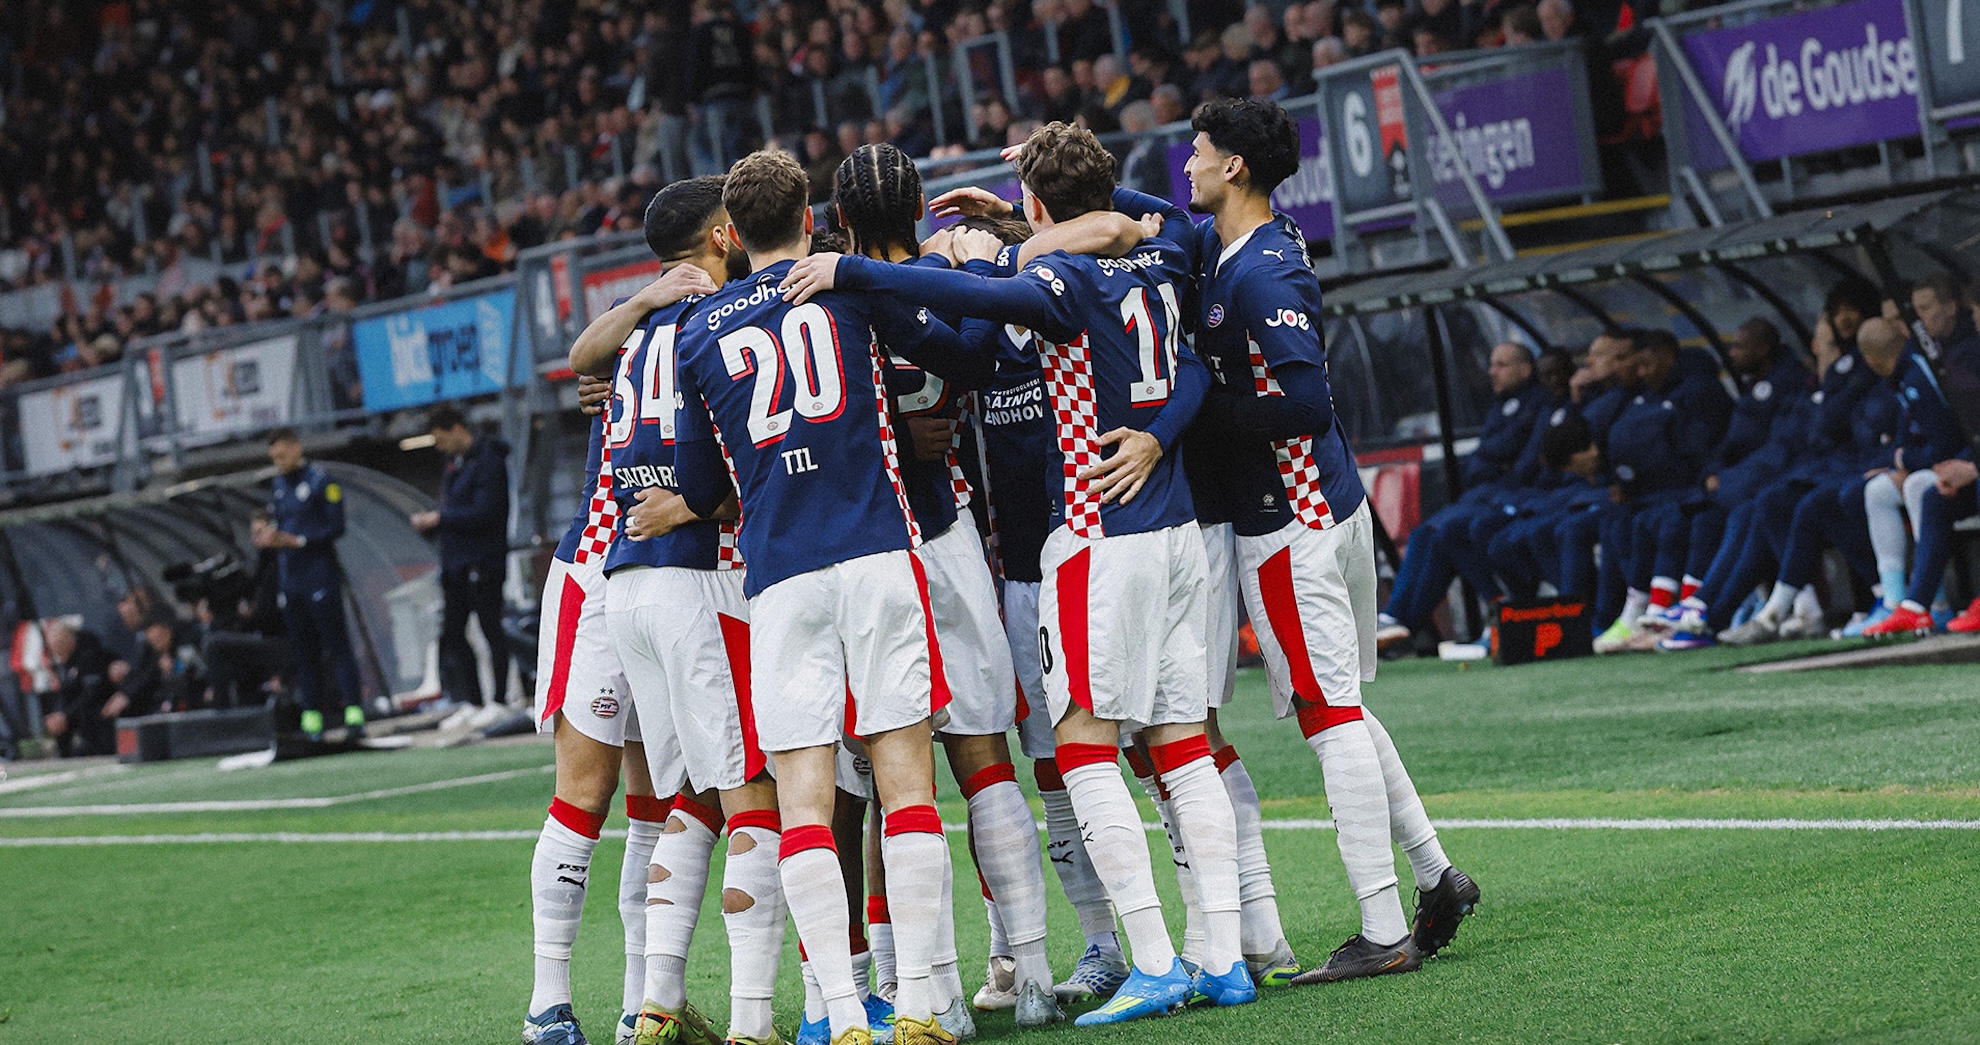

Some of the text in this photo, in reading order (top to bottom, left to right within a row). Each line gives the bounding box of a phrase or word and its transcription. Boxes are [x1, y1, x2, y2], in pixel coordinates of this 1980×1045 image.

[1760, 42, 1803, 120] de
[1801, 22, 1919, 111] Goudse
[1343, 91, 1373, 178] 6
[611, 323, 678, 449] 34
[717, 302, 847, 450] 20
[781, 447, 819, 476] TIL
